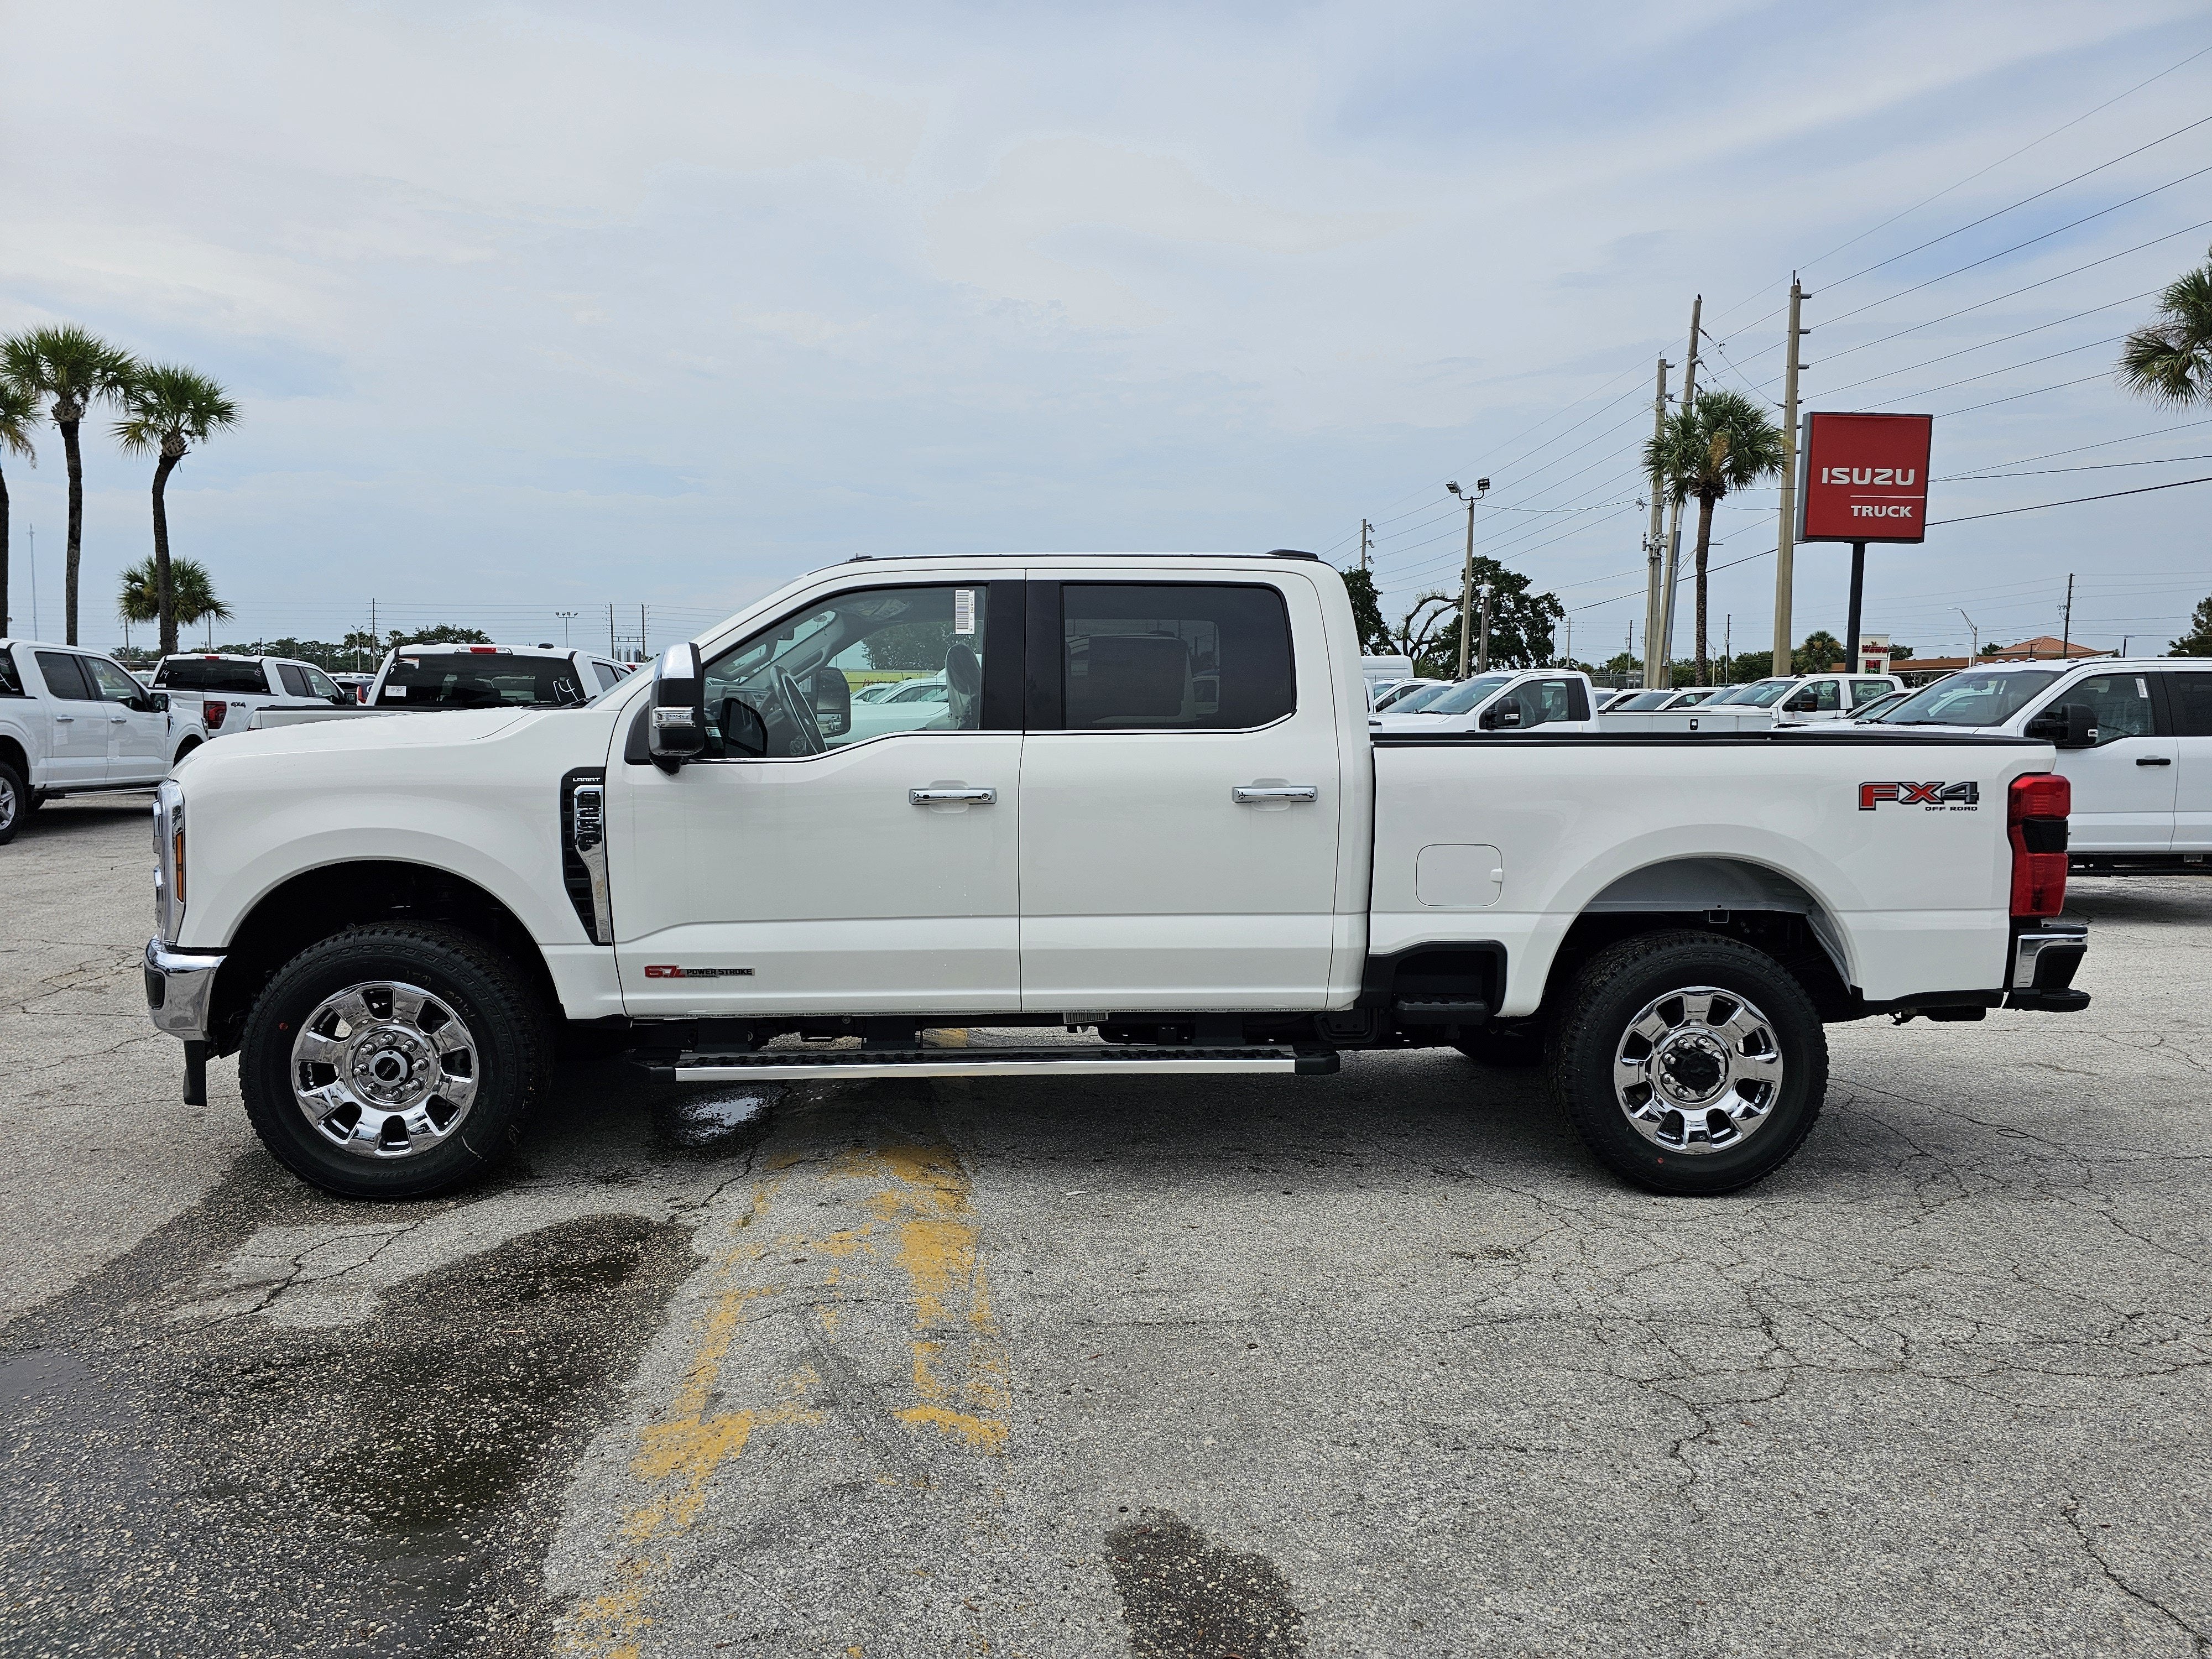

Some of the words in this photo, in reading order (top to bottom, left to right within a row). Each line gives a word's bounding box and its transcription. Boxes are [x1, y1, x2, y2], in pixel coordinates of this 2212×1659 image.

[1822, 467, 1915, 486] ISUZU
[1850, 505, 1913, 518] TRUCK
[552, 679, 578, 702] 14
[1859, 781, 1979, 811] FX4
